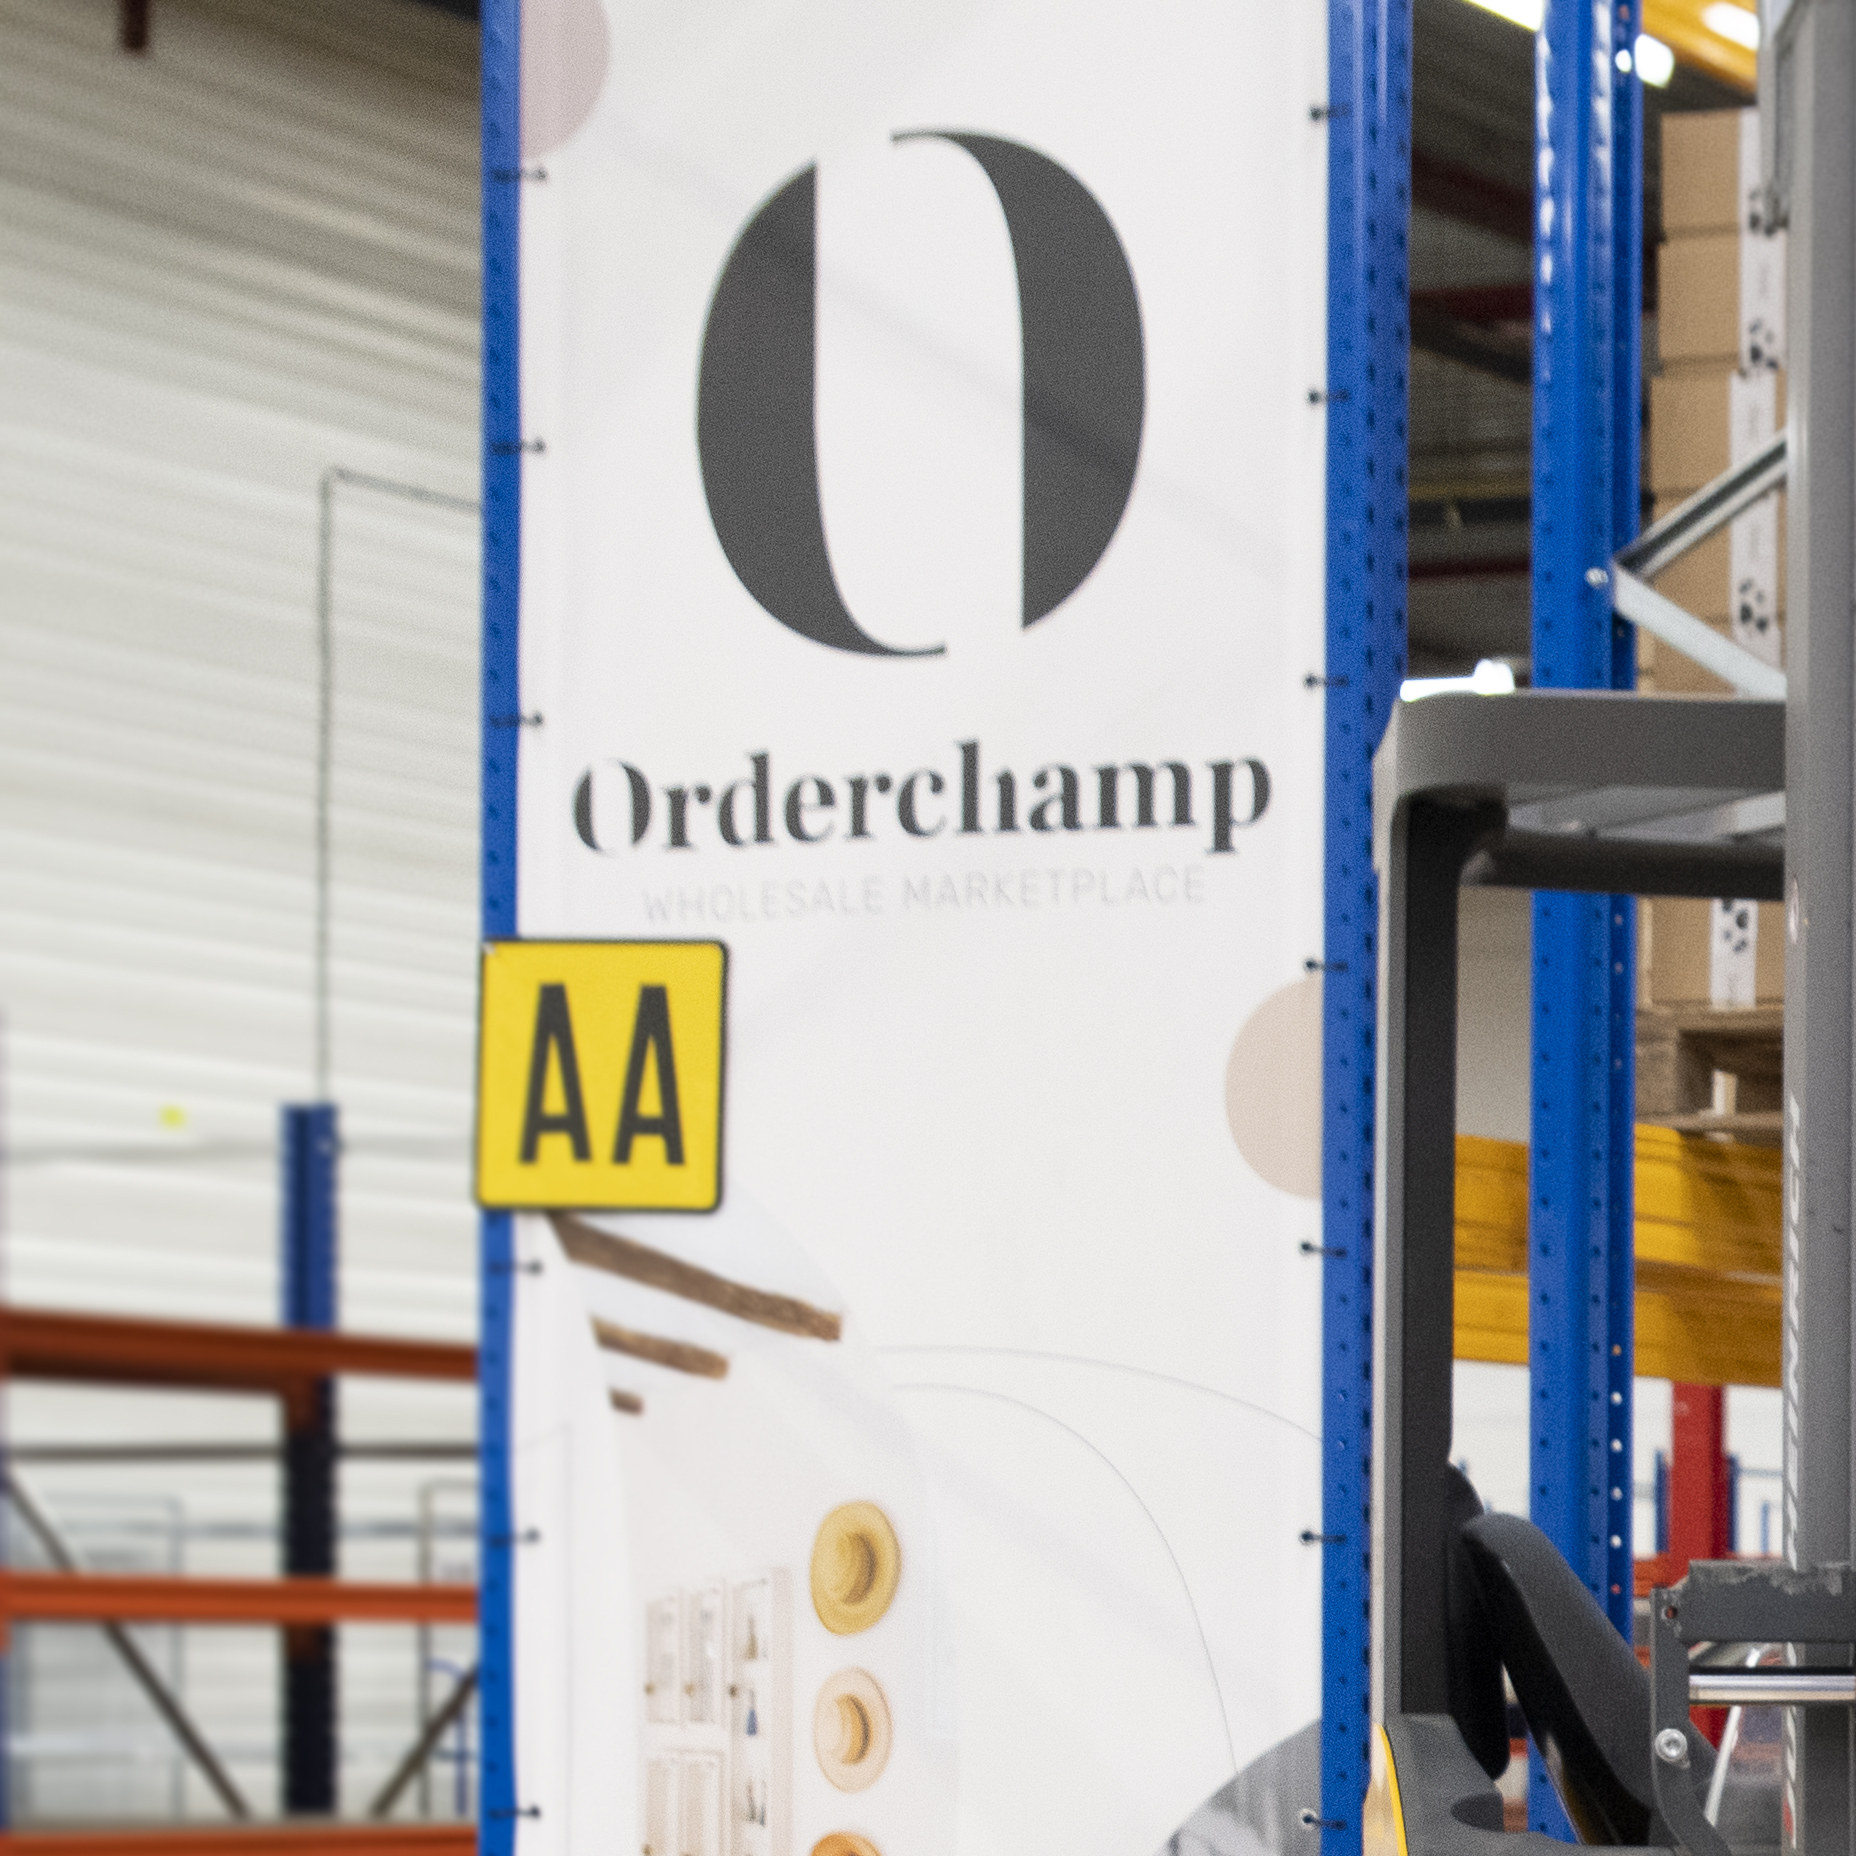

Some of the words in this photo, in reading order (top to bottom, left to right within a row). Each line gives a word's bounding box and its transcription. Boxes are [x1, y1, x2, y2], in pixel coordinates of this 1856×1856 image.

[571, 739, 1272, 855] Orderchamp
[642, 873, 886, 925] WHOLESALE
[901, 864, 1206, 914] MARKETPLACE
[519, 981, 686, 1165] AA
